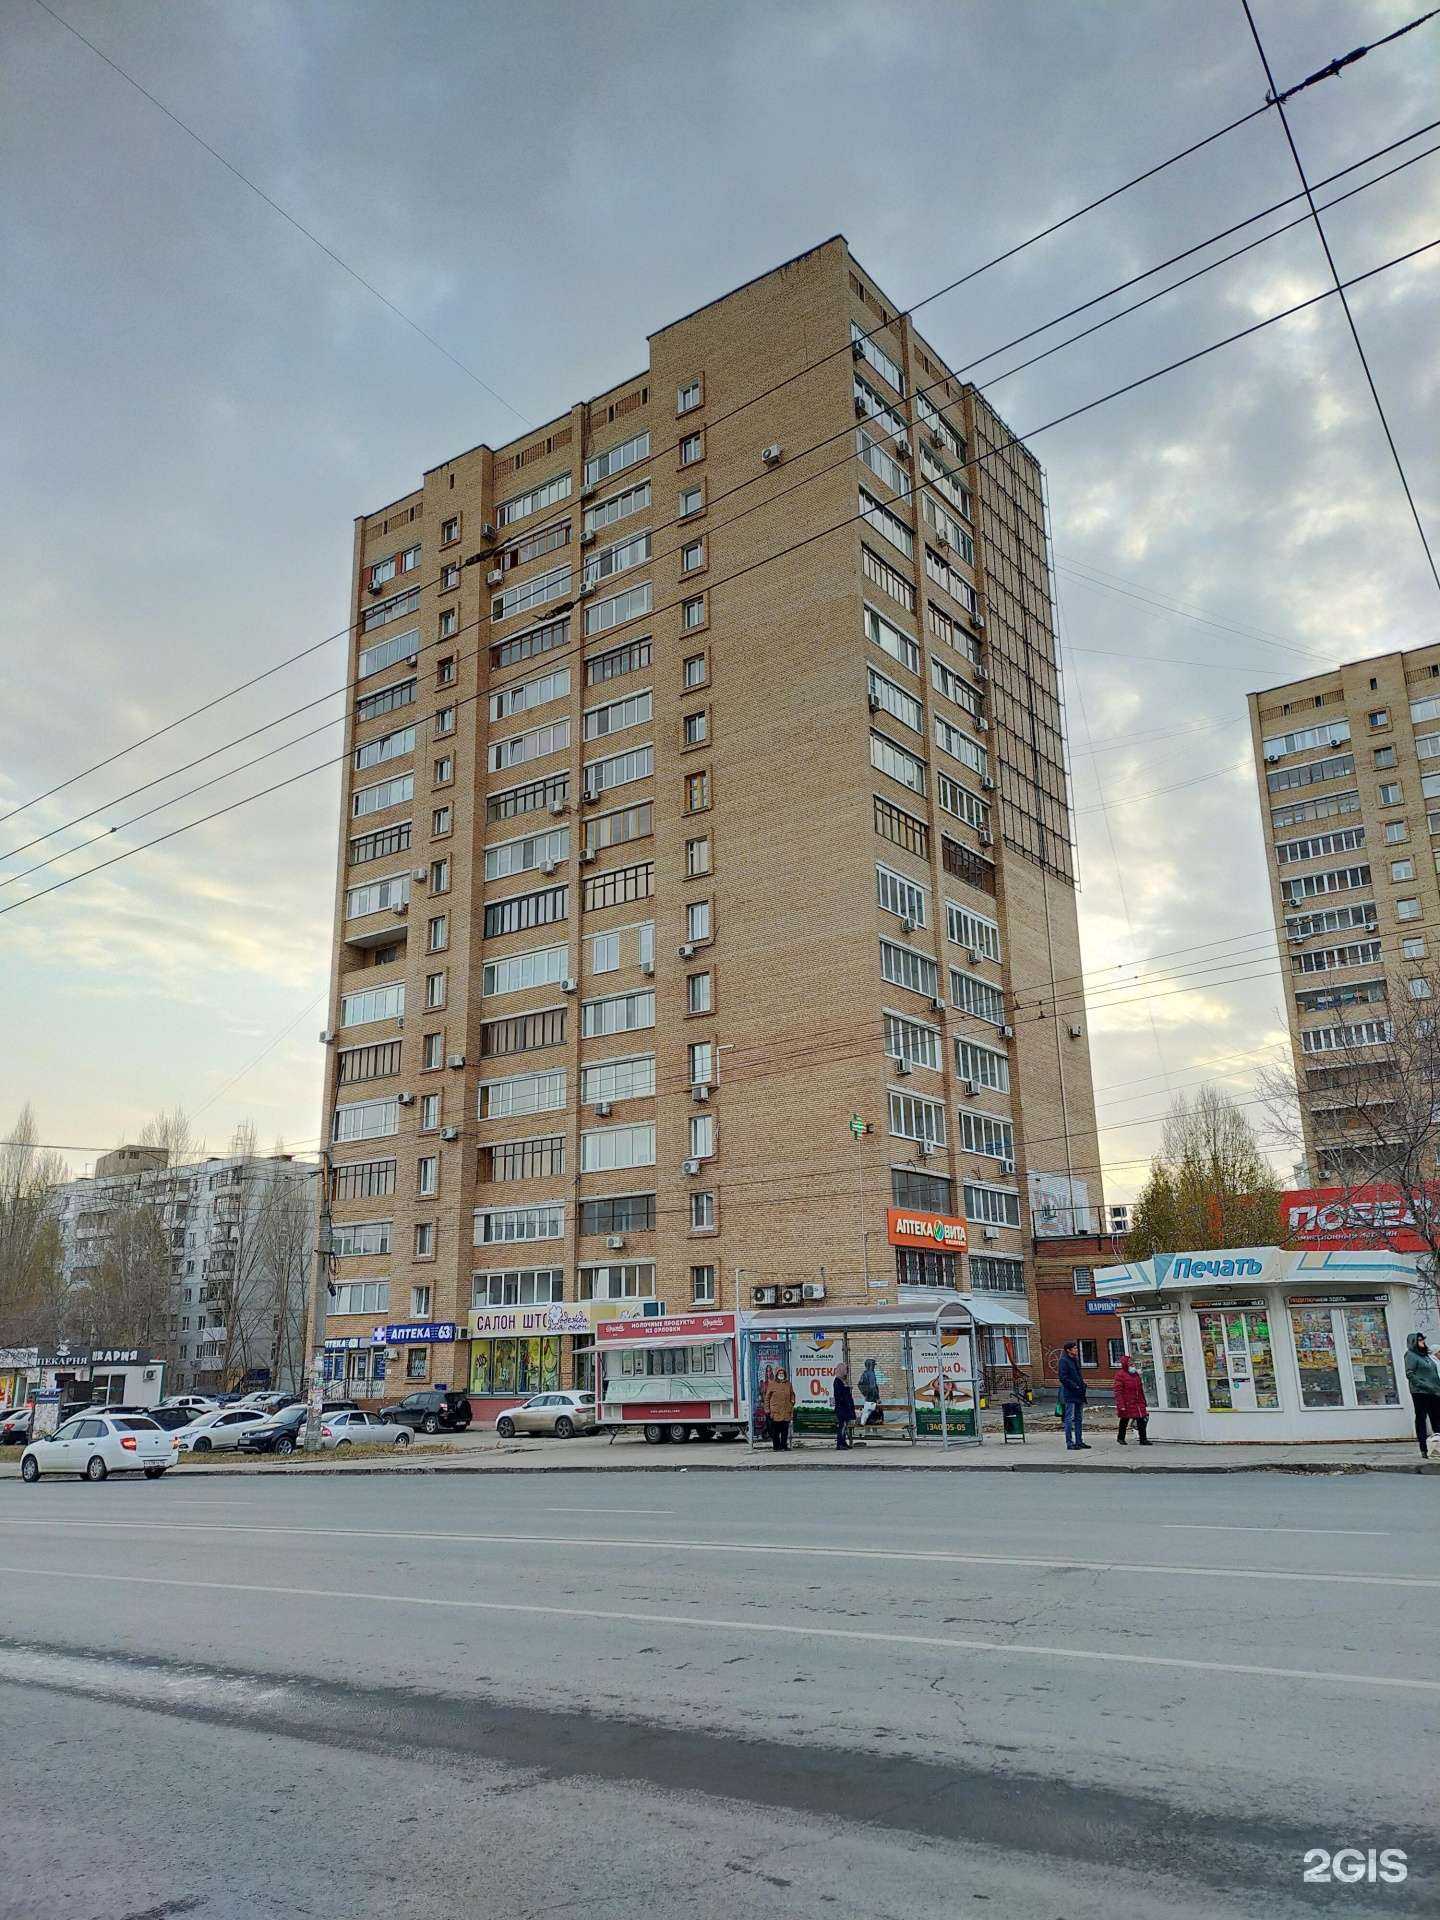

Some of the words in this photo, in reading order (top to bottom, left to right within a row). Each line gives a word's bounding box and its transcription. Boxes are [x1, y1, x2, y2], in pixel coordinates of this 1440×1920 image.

[896, 1218, 934, 1237] АПТЕКА
[944, 1224, 967, 1241] ВИТА
[1173, 1256, 1263, 1279] Печать
[477, 1315, 516, 1331] САЛОН
[631, 1321, 663, 1329] МОЛОЧНЫЕ
[663, 1319, 696, 1327] ПРОДУКТЫ
[391, 1327, 431, 1340] АПТЕКА
[438, 1325, 453, 1339] 63
[325, 1339, 346, 1348] ПТЕКА
[37, 1357, 88, 1366] ПЕКАРНЯ
[917, 1365, 953, 1373] ИПОТКА
[810, 1379, 830, 1397] 0%
